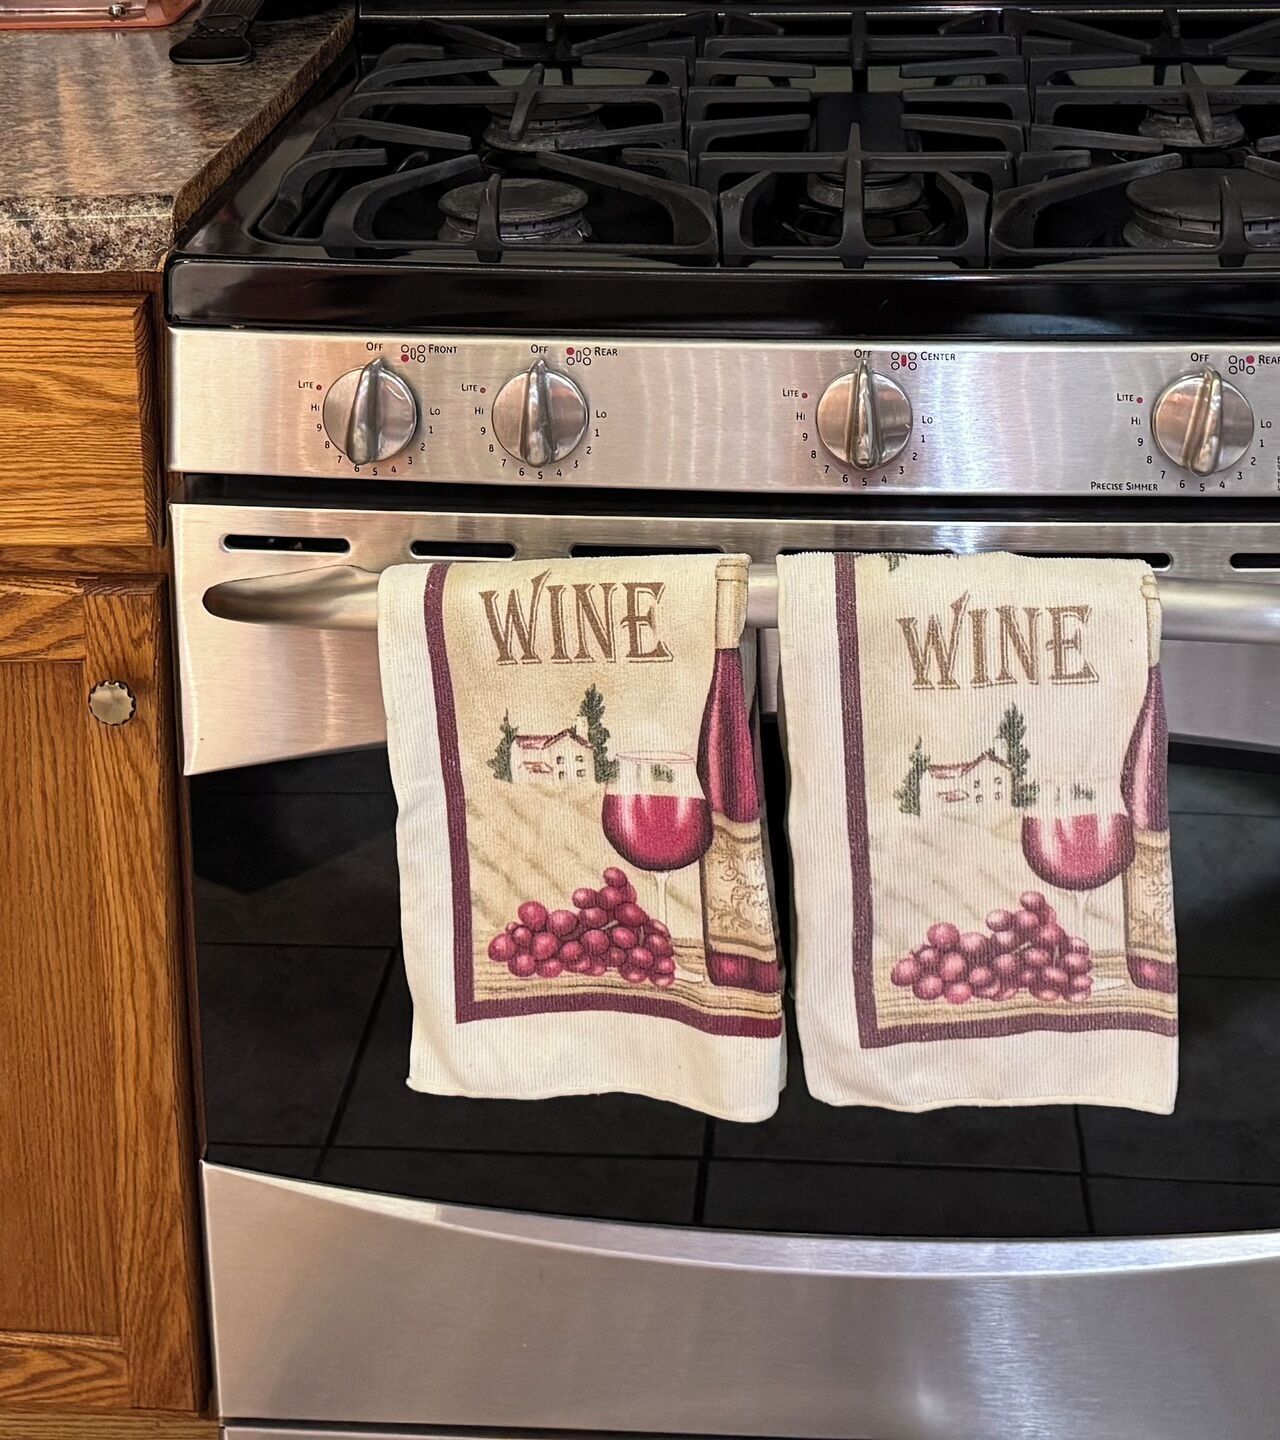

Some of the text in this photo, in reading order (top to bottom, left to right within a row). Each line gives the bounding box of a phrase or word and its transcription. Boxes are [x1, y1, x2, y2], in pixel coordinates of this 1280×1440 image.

[366, 342, 383, 351] OFF
[428, 344, 457, 353] FRONT
[531, 344, 548, 353] OFF
[594, 347, 618, 356] REAR
[854, 349, 872, 358] OFF
[920, 352, 955, 361] CENTER
[1190, 353, 1209, 362] OFF
[298, 380, 313, 389] LITE
[461, 384, 478, 392] LITE
[782, 389, 799, 397] LITE
[1116, 393, 1134, 402] LITE
[317, 424, 322, 432] 9
[429, 426, 433, 434] 1
[480, 427, 486, 435] 9
[595, 429, 599, 437] 1
[802, 433, 808, 441] 9
[921, 435, 925, 443] 1
[1137, 438, 1144, 447] 9
[1259, 439, 1264, 447] 1
[421, 443, 425, 451] 2
[502, 459, 507, 467] 7
[574, 460, 579, 468] 3
[1147, 456, 1152, 464] 8
[1251, 457, 1256, 465] 2
[391, 465, 396, 473] 4
[519, 468, 524, 476] 6
[825, 465, 829, 473] 7
[899, 466, 904, 474] 3
[538, 471, 543, 479] 5
[843, 475, 848, 483] 6
[882, 475, 887, 483] 4
[1161, 471, 1166, 479] 7
[1237, 472, 1242, 480] 3
[862, 478, 867, 486] 5
[1180, 480, 1185, 488] 6
[1220, 480, 1225, 489] 4
[1090, 482, 1158, 491] PRECISE SIMMER
[1200, 483, 1205, 492] 5
[478, 568, 674, 666] WINE
[896, 590, 1099, 690] WINE
